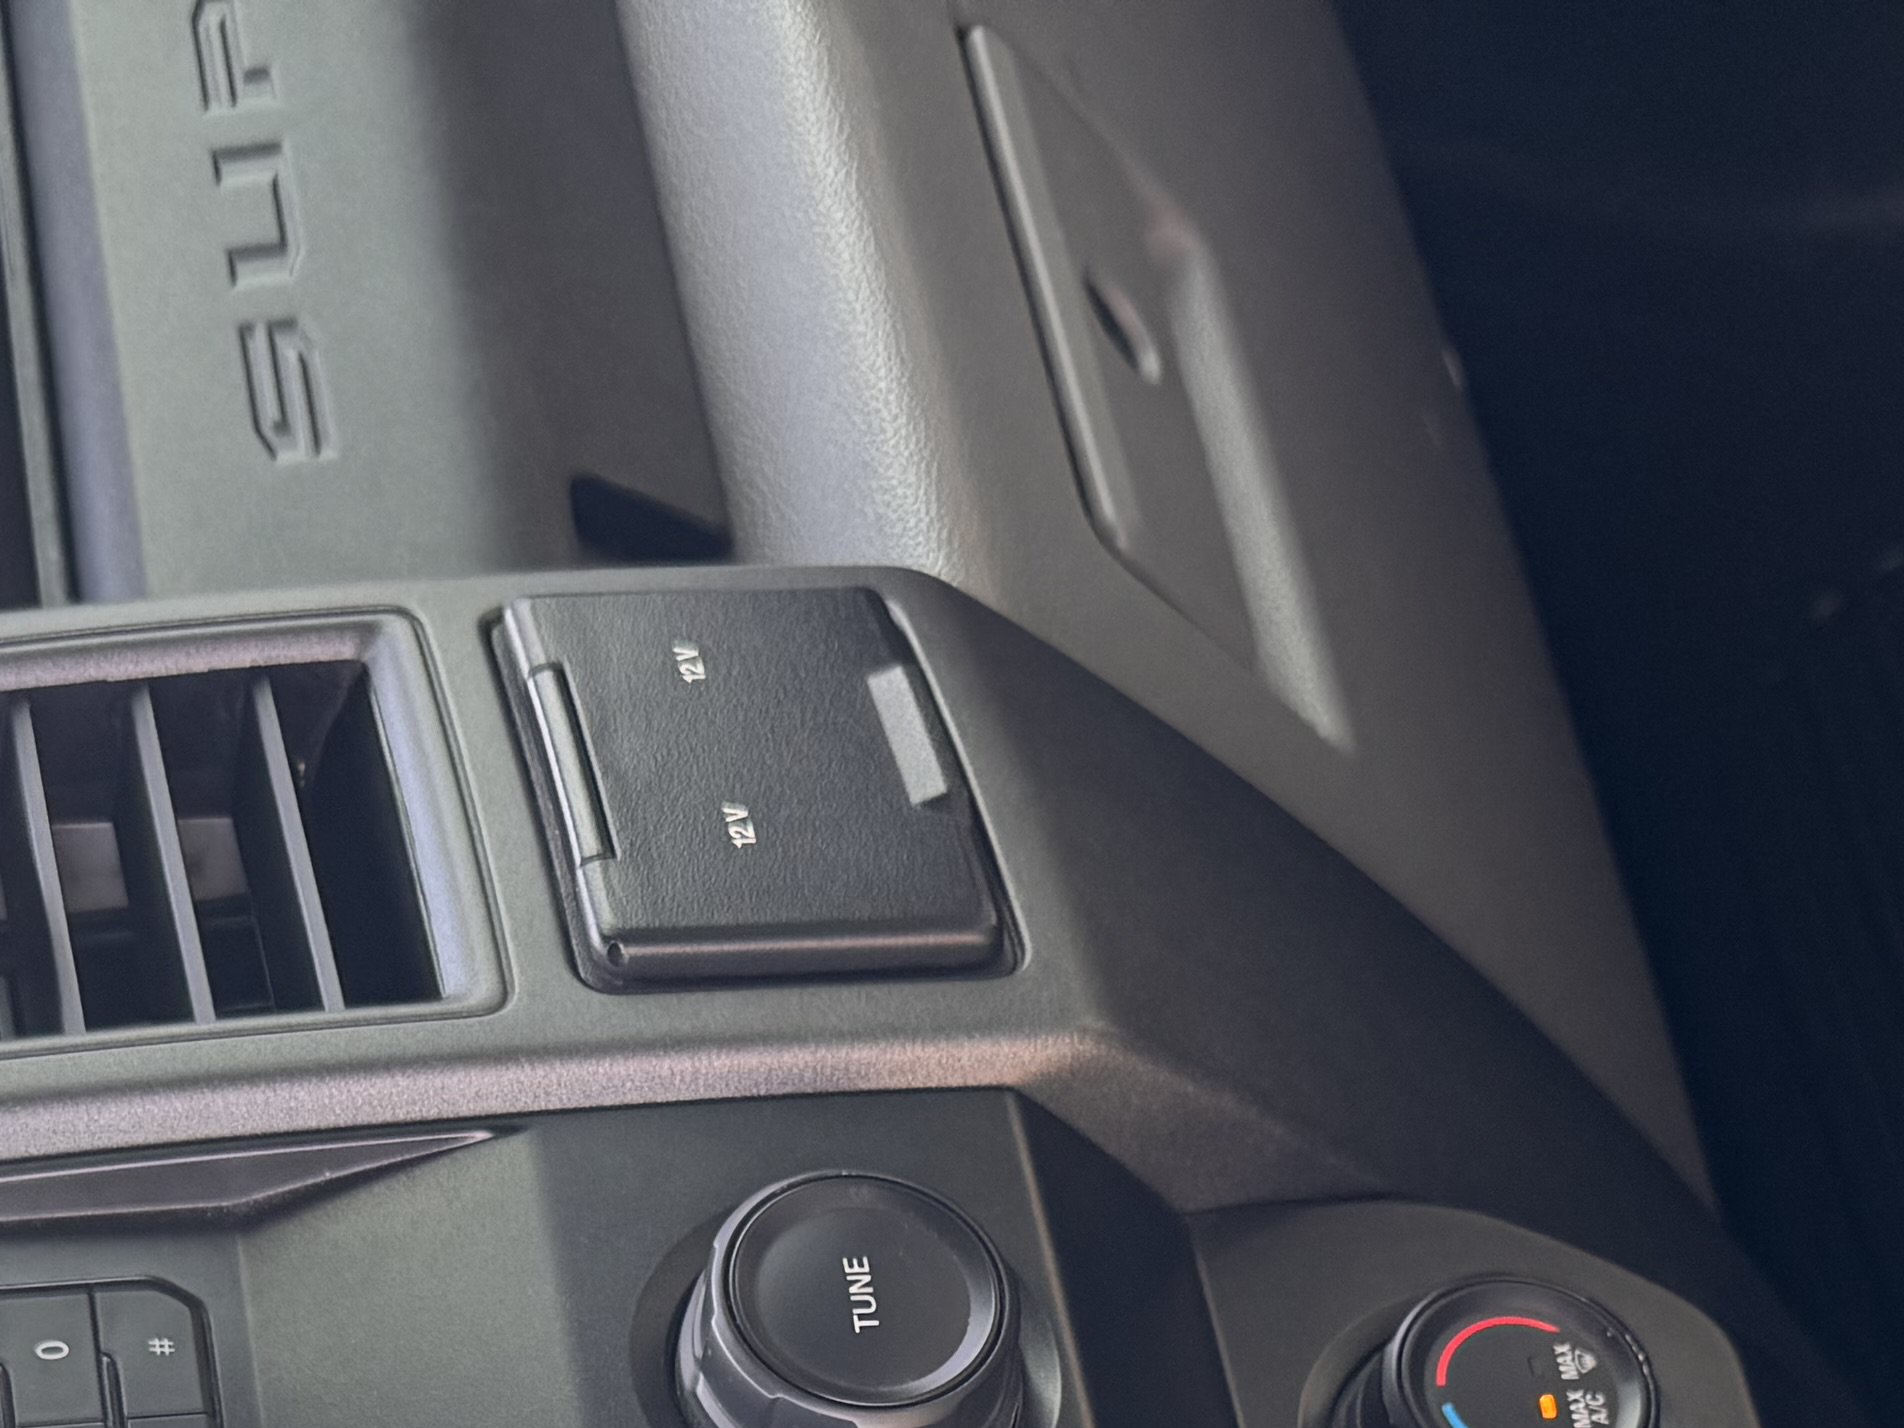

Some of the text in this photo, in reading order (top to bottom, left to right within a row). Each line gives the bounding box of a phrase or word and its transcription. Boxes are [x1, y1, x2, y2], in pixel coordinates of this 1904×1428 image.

[672, 646, 706, 683] 12V
[722, 803, 757, 849] 12V
[842, 1256, 880, 1334] TUNE
[35, 1340, 70, 1360] 0
[1553, 1343, 1578, 1380] MAX
[1566, 1390, 1591, 1428] MAX
[1584, 1392, 1609, 1425] A/C
